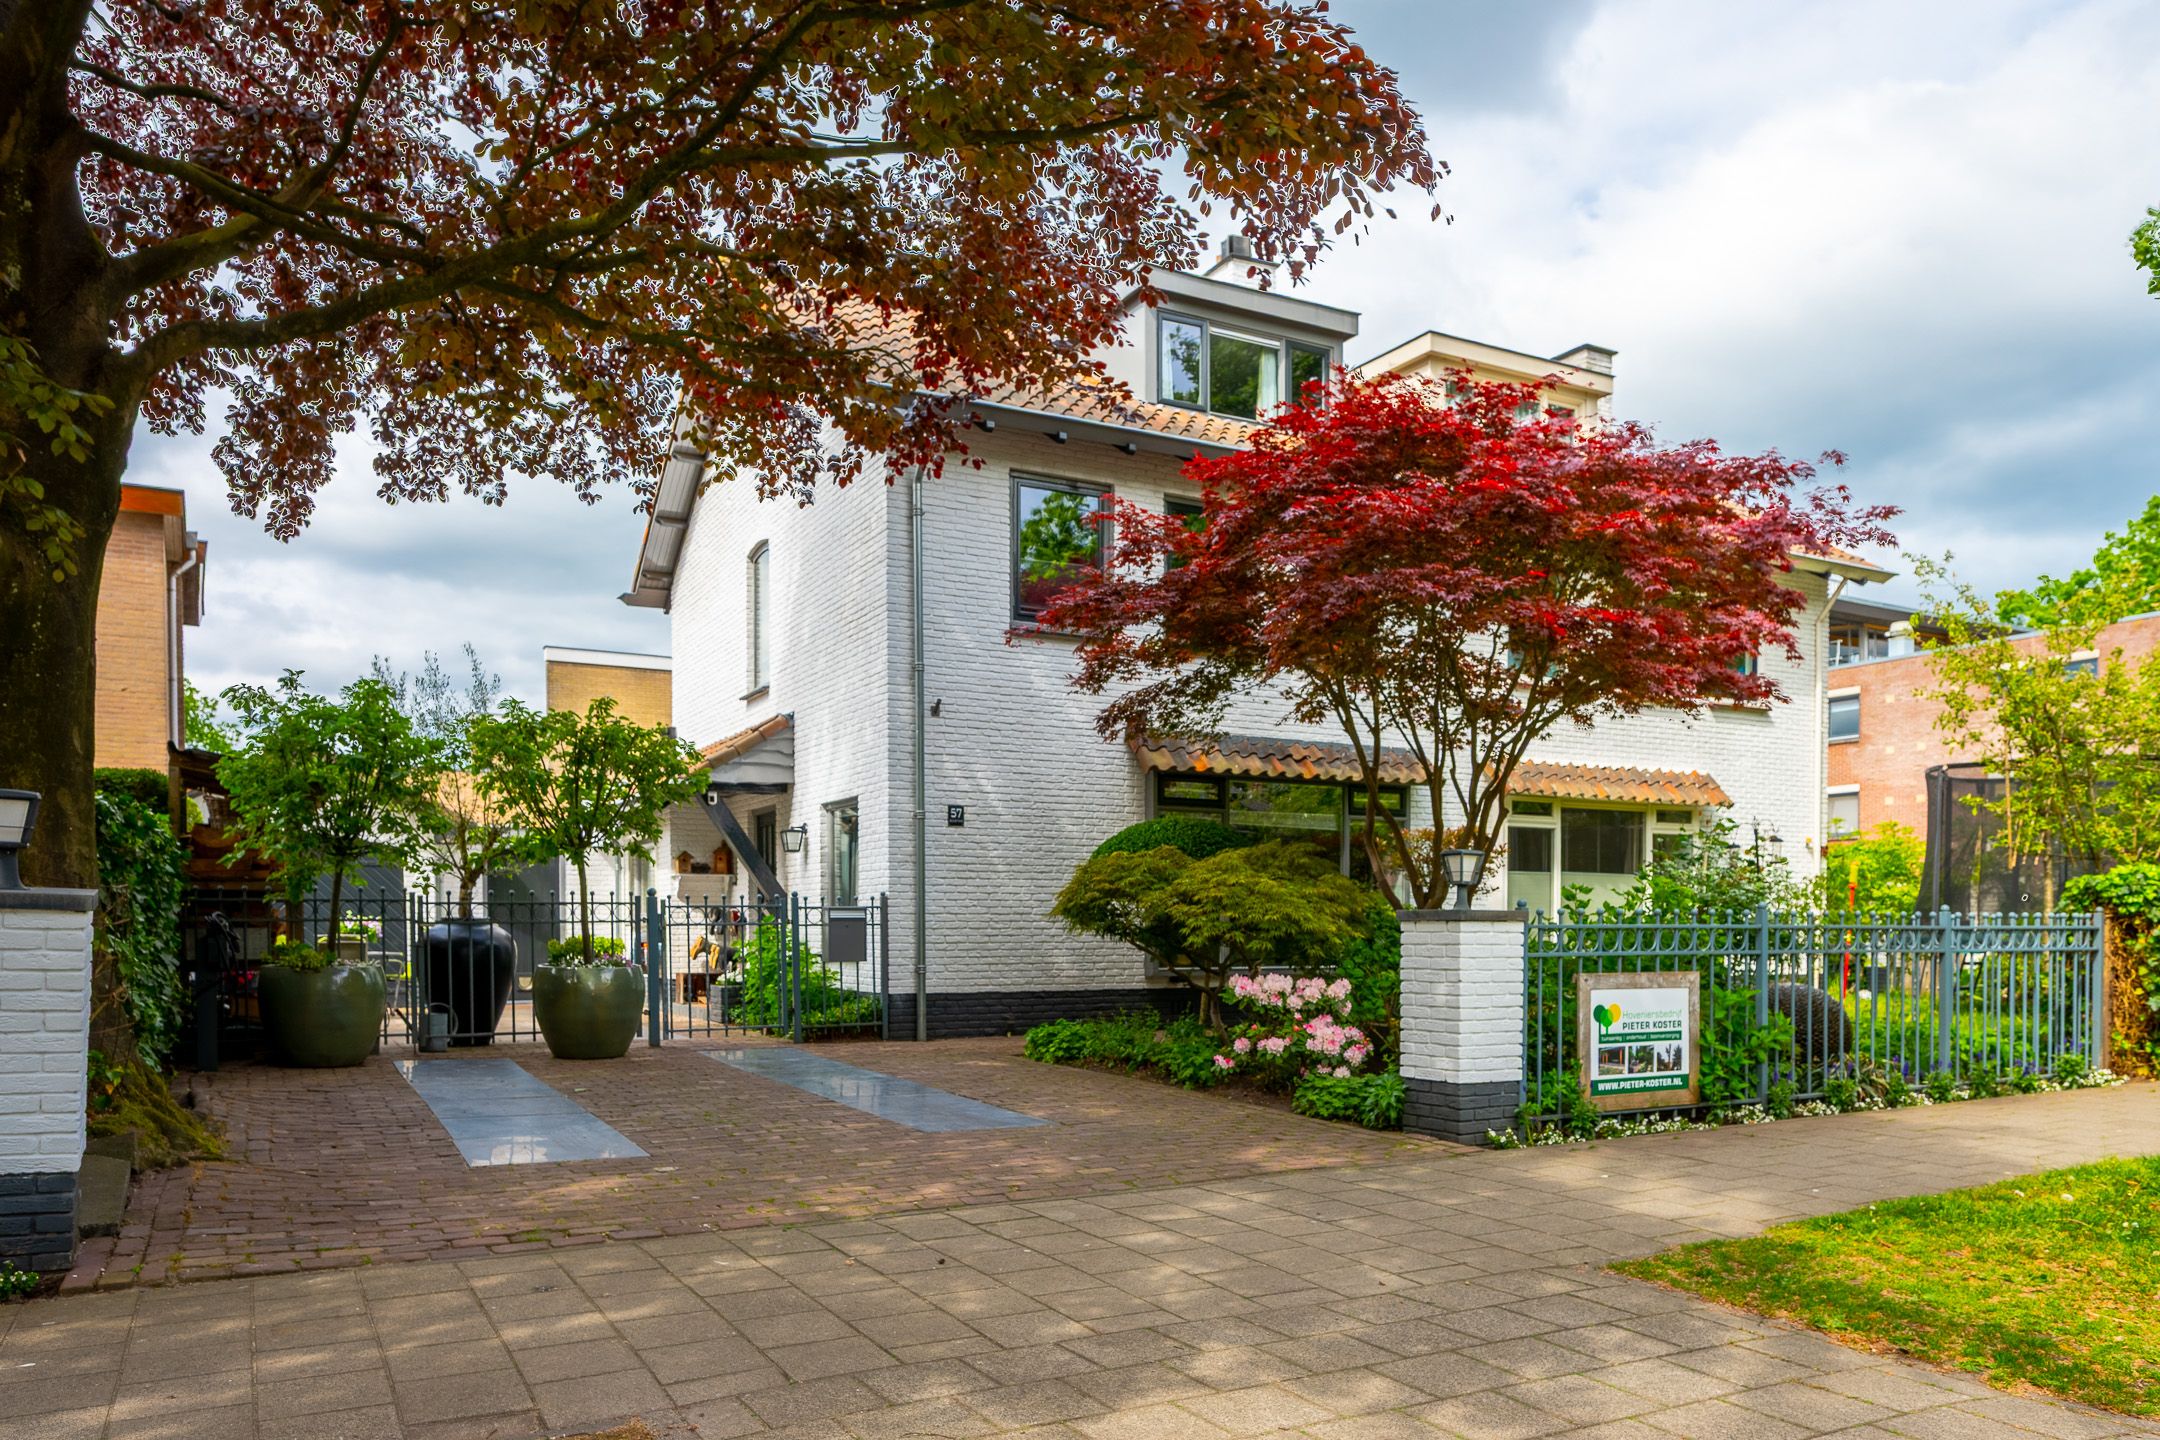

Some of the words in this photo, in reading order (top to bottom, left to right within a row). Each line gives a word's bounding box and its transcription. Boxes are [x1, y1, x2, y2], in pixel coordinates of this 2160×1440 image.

[950, 807, 962, 818] 57
[1622, 1021, 1650, 1030] PIETER
[1653, 1020, 1682, 1029] KOSTER
[1598, 1077, 1683, 1091] WWW.PIETER-KOSTER.NL
